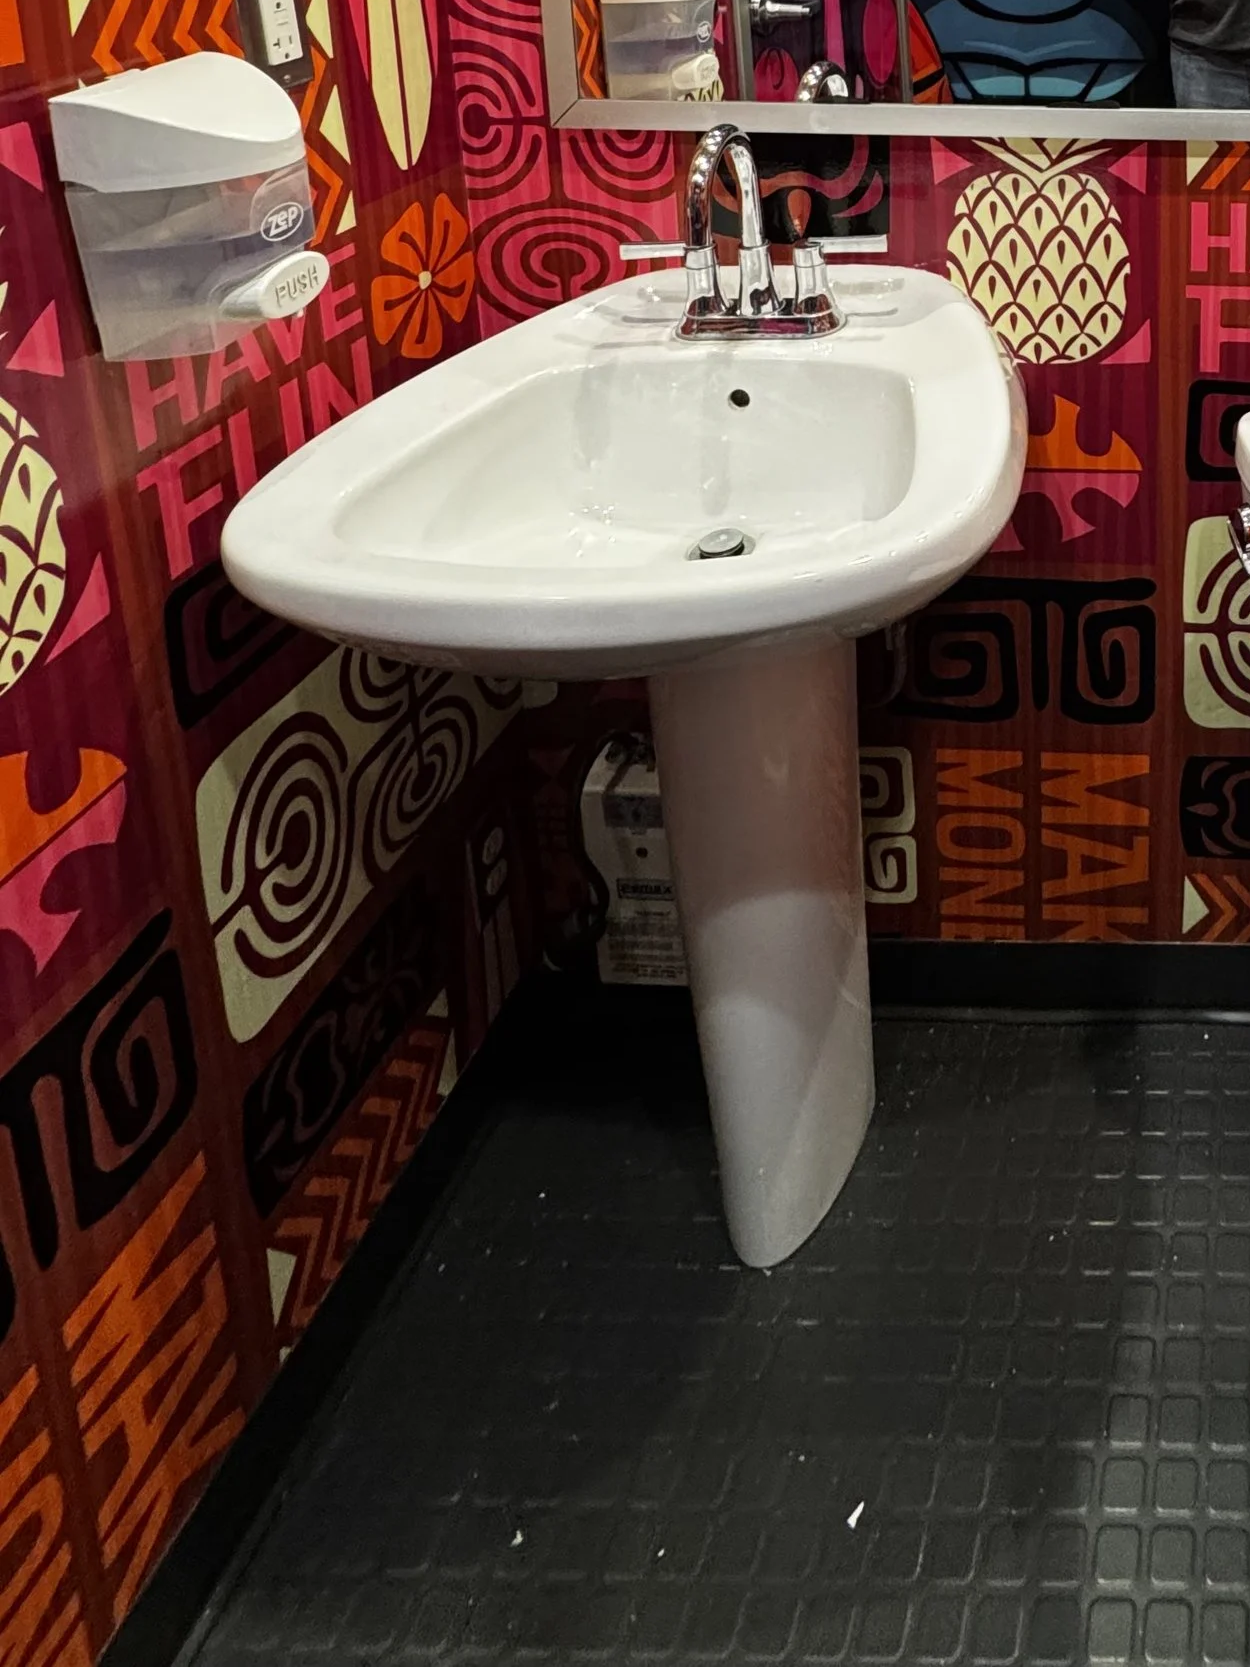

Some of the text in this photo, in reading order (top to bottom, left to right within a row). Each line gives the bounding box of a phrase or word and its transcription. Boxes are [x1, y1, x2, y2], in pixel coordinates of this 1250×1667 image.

[275, 263, 320, 309] PUSH
[936, 748, 1026, 941] MON
[1041, 751, 1150, 942] MAK
[62, 1150, 247, 1626] MAK
